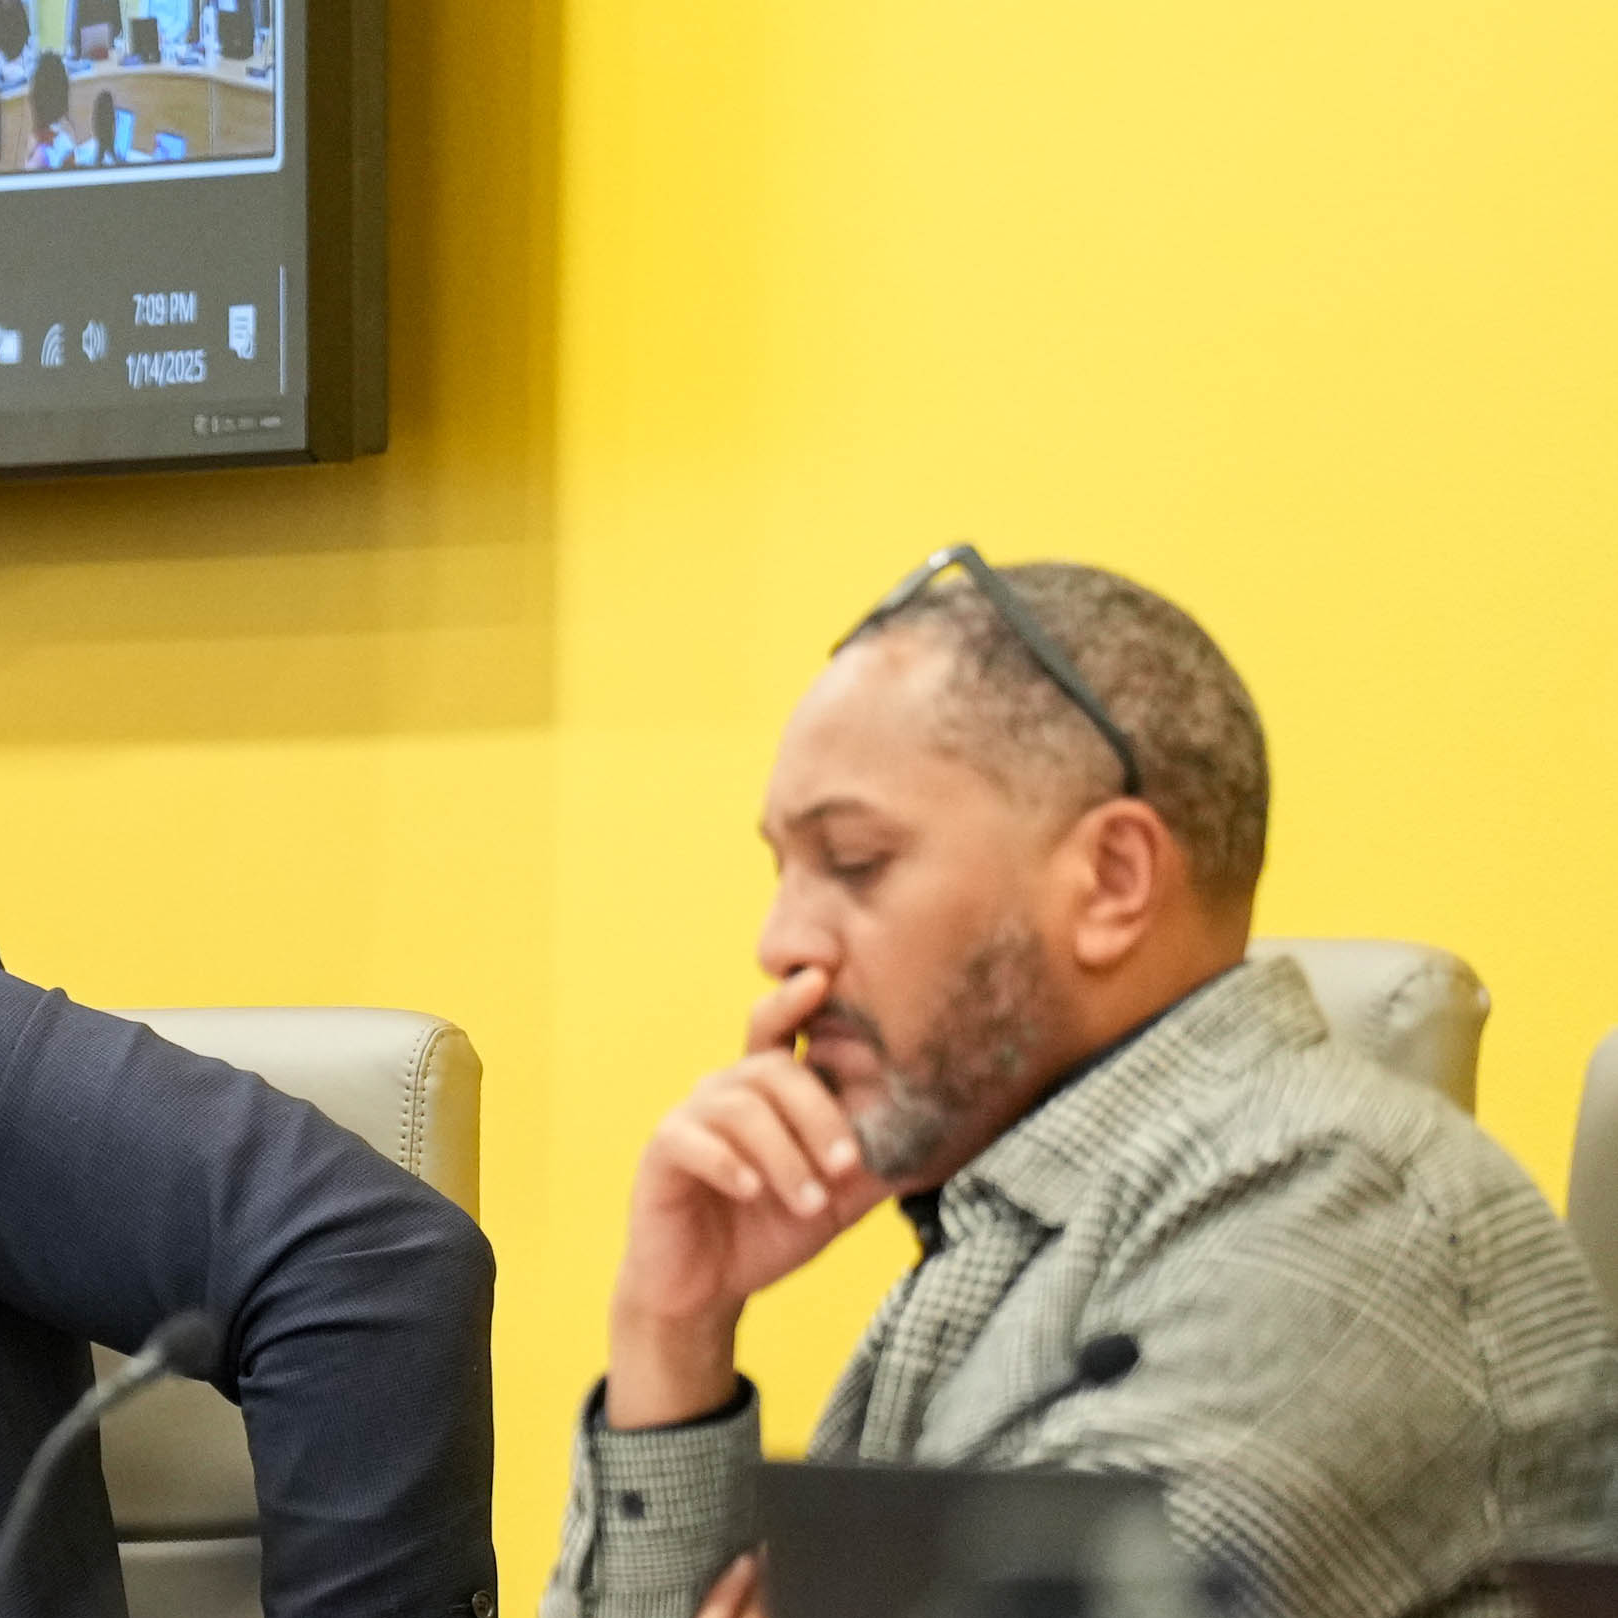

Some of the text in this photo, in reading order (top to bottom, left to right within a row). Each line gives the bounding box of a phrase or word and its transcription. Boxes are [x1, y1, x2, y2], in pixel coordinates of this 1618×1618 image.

[133, 291, 197, 326] 7:09 PM
[126, 349, 207, 389] 1/14/2025
